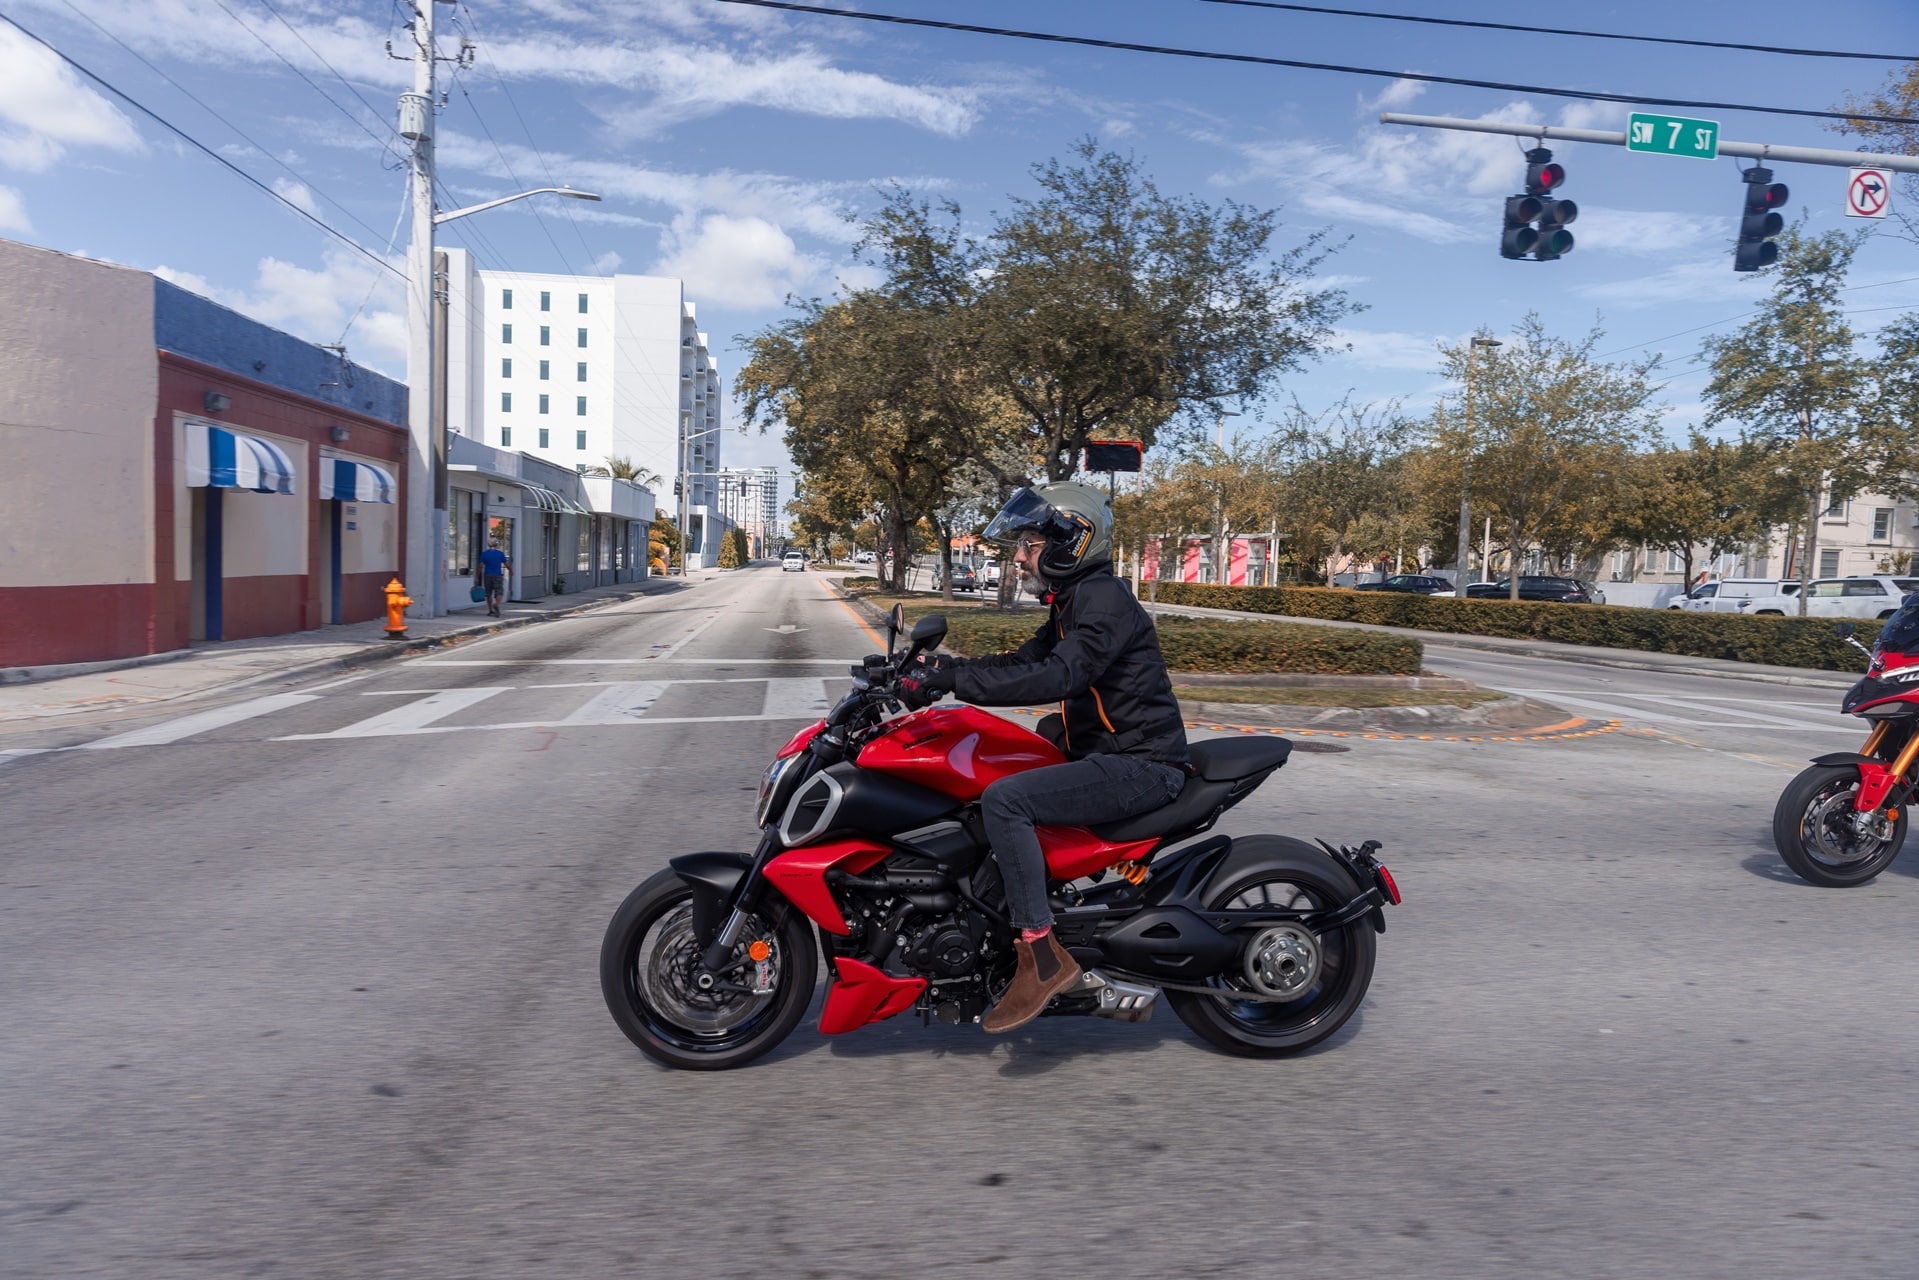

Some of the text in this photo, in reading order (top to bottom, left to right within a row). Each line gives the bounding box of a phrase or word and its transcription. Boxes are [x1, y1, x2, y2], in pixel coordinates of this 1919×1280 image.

[1631, 121, 1713, 151] SW 7 ST
[1071, 529, 1088, 557] DUCATI
[902, 731, 943, 750] DUCATI
